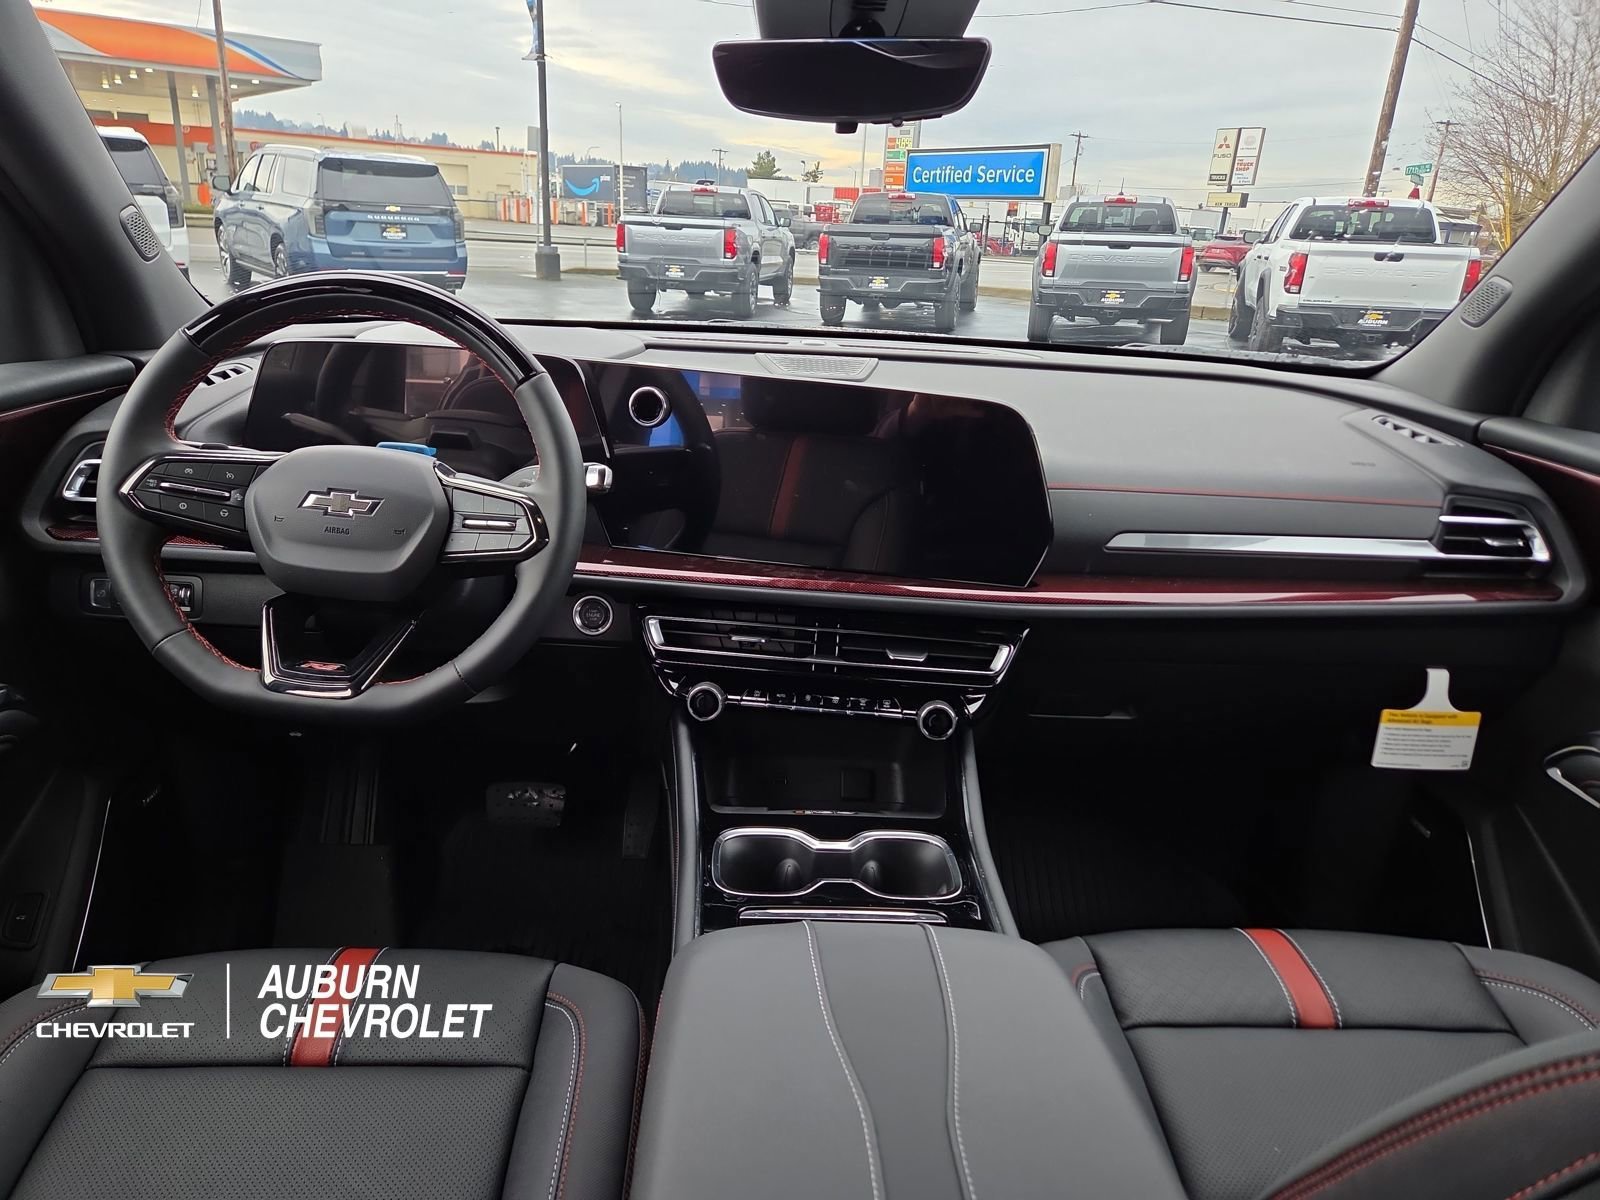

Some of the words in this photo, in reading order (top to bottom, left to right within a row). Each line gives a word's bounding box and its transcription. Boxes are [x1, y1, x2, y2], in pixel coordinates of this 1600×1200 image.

[912, 165, 973, 184] Certified
[977, 165, 1035, 184] Service
[1069, 253, 1169, 264] CHEVROLET
[324, 526, 351, 535] AIRBAG
